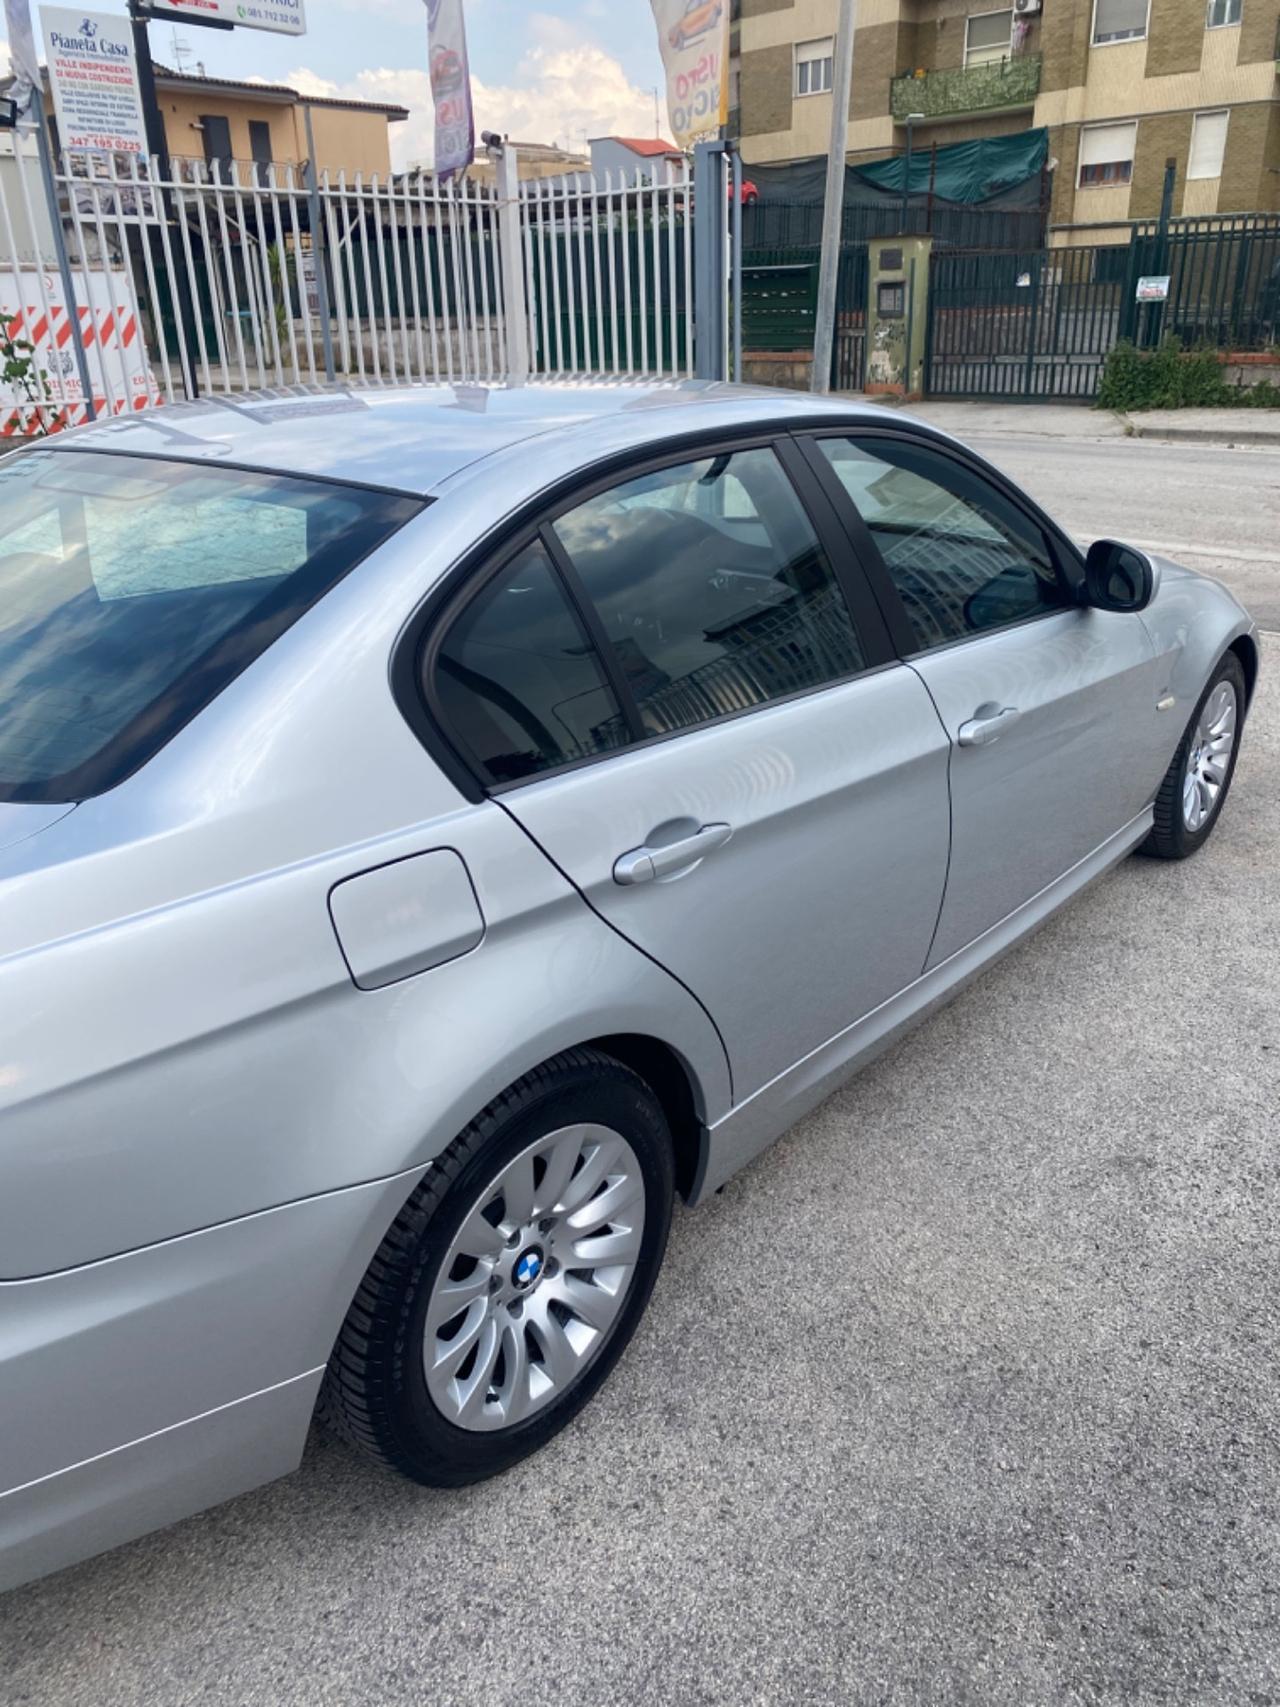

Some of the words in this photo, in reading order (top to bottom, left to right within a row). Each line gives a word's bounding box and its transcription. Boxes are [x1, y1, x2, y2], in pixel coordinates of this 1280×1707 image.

[50, 31, 97, 53] Pianeta
[100, 38, 129, 57] Casa
[55, 59, 77, 69] VILLE
[65, 70, 89, 81] NUOVA
[89, 73, 133, 86] COSTRUZIONE
[69, 136, 89, 146] 347
[94, 137, 113, 148] 195
[115, 140, 141, 152] 0225
